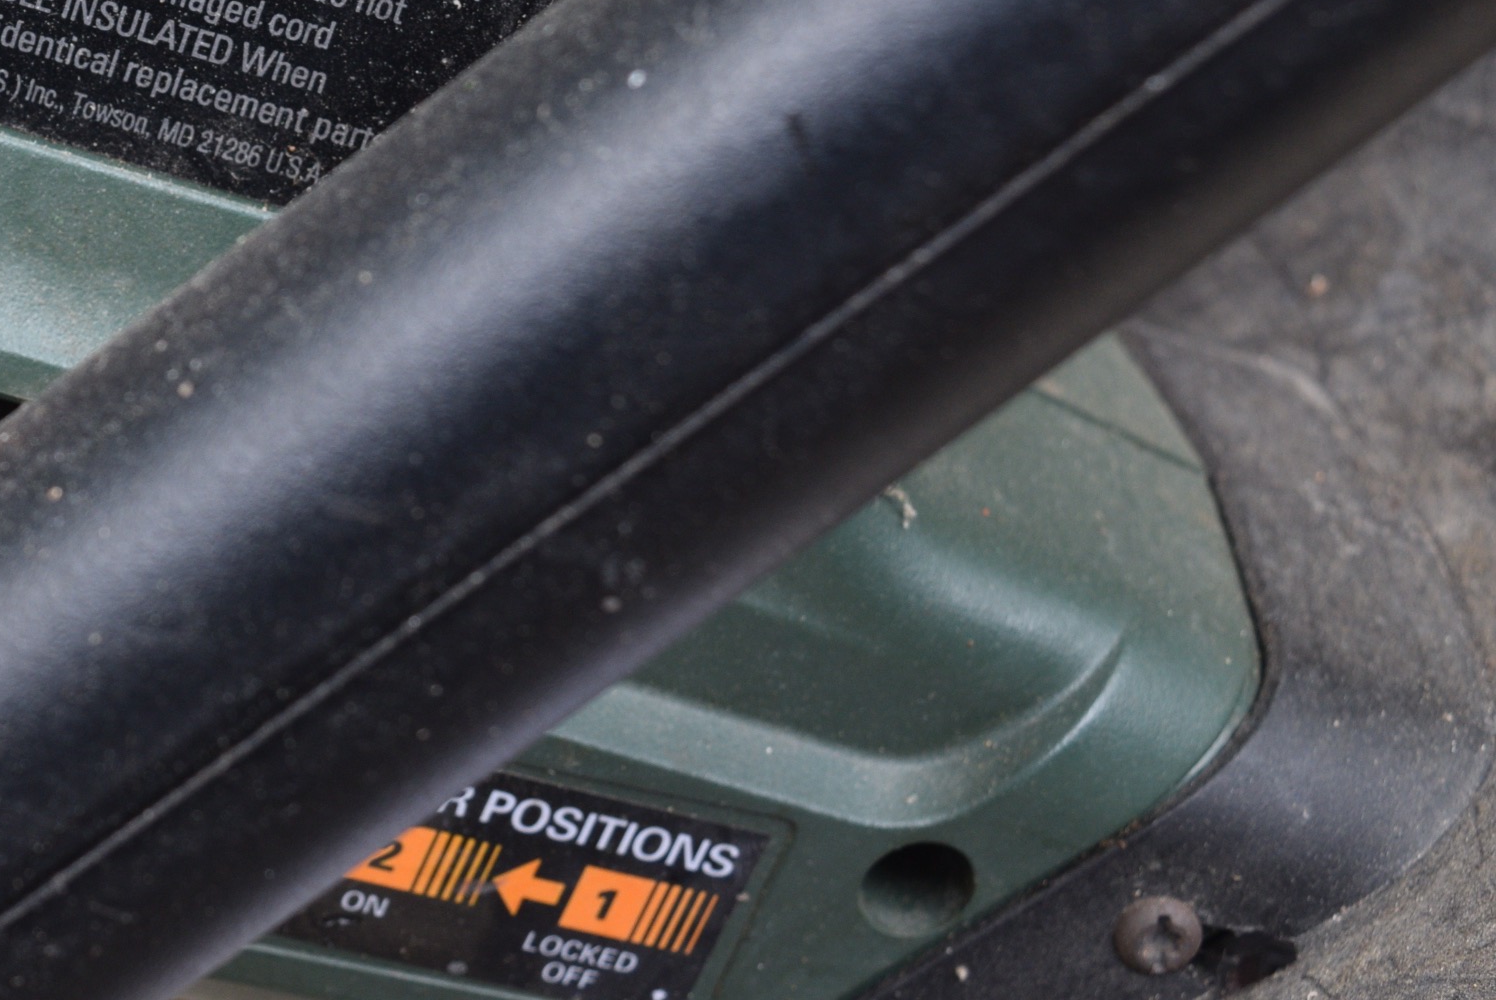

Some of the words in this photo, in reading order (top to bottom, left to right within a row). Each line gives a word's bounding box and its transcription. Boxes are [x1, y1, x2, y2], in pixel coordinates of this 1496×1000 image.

[269, 10, 337, 50] cord
[242, 42, 327, 94] When
[123, 60, 308, 133] replacement
[71, 91, 150, 138] Towson,
[158, 118, 194, 147] MD
[197, 130, 261, 168] 21286
[479, 788, 740, 880] POSITIONS
[368, 841, 403, 872] 2
[340, 889, 391, 919] ON
[596, 887, 623, 921] 1
[521, 930, 639, 974] LOCKED
[541, 961, 600, 989] OFF
